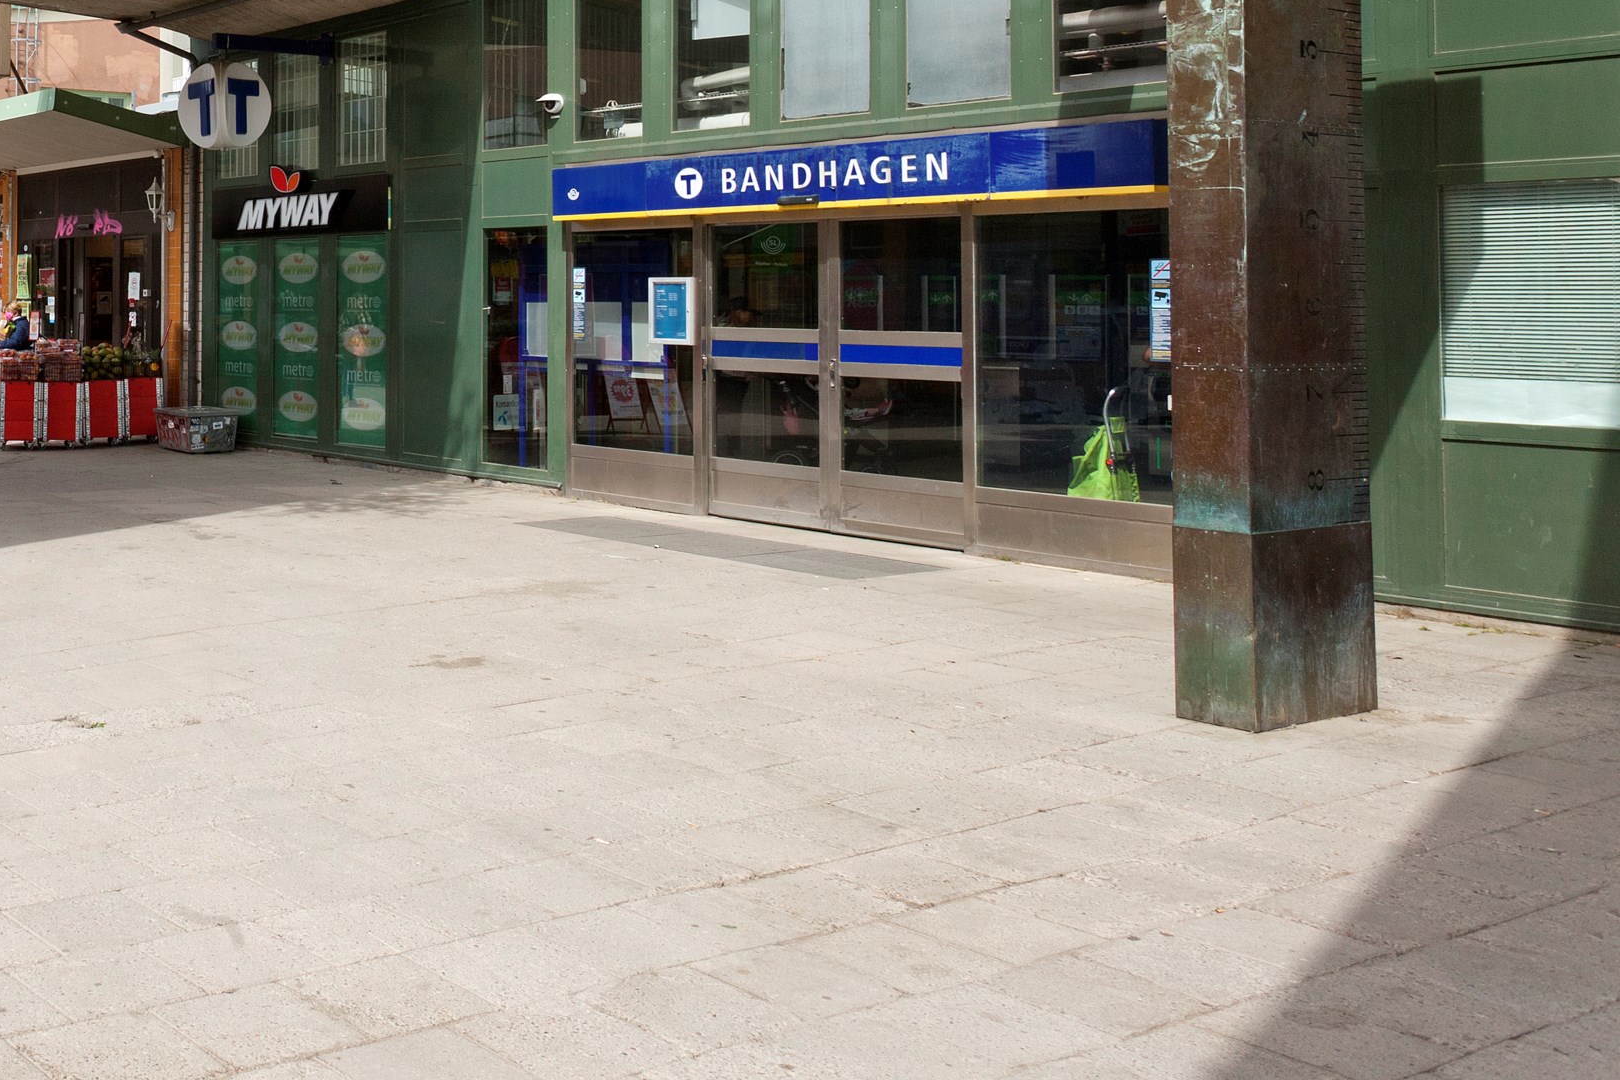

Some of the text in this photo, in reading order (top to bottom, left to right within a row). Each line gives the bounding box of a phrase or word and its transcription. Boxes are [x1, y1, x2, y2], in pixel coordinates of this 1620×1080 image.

[1300, 40, 1317, 59] 3
[187, 77, 216, 137] T
[227, 77, 260, 135] T
[1302, 130, 1318, 147] 4
[721, 151, 949, 195] BANDHAGEN
[237, 191, 340, 231] MYWAY
[1299, 209, 1320, 231] 5
[225, 295, 253, 308] metro
[282, 295, 314, 307] metro
[347, 295, 381, 308] metro
[225, 361, 253, 373] metro
[282, 364, 314, 377] metro
[347, 370, 381, 382] metro
[1306, 384, 1323, 401] 7
[1307, 469, 1324, 491] 8
